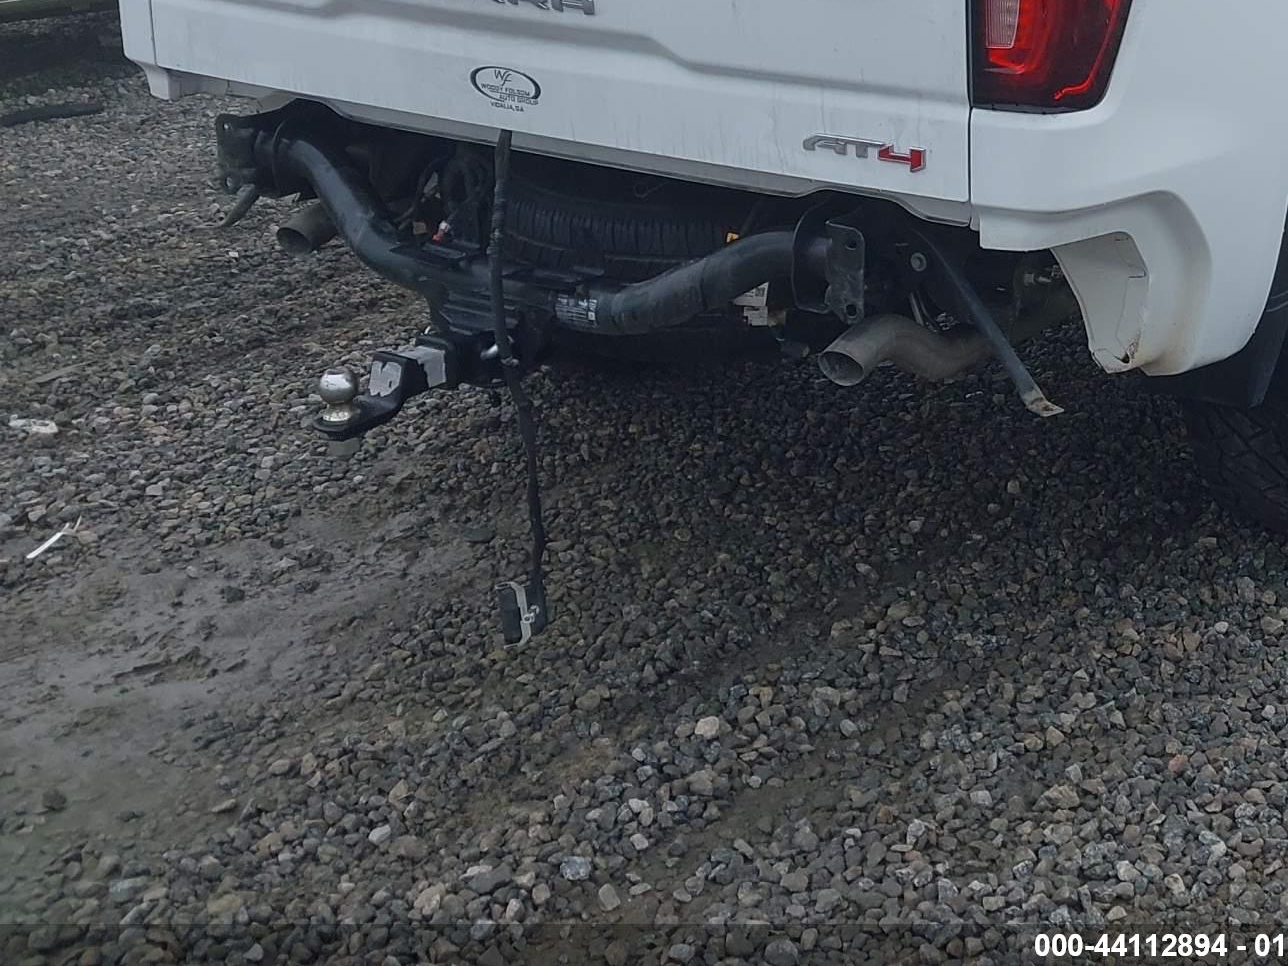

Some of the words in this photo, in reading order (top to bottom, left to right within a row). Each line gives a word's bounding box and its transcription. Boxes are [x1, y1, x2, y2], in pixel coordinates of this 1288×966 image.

[499, 94, 516, 102] AUTO
[517, 97, 539, 105] GROUP
[803, 133, 926, 173] AT4
